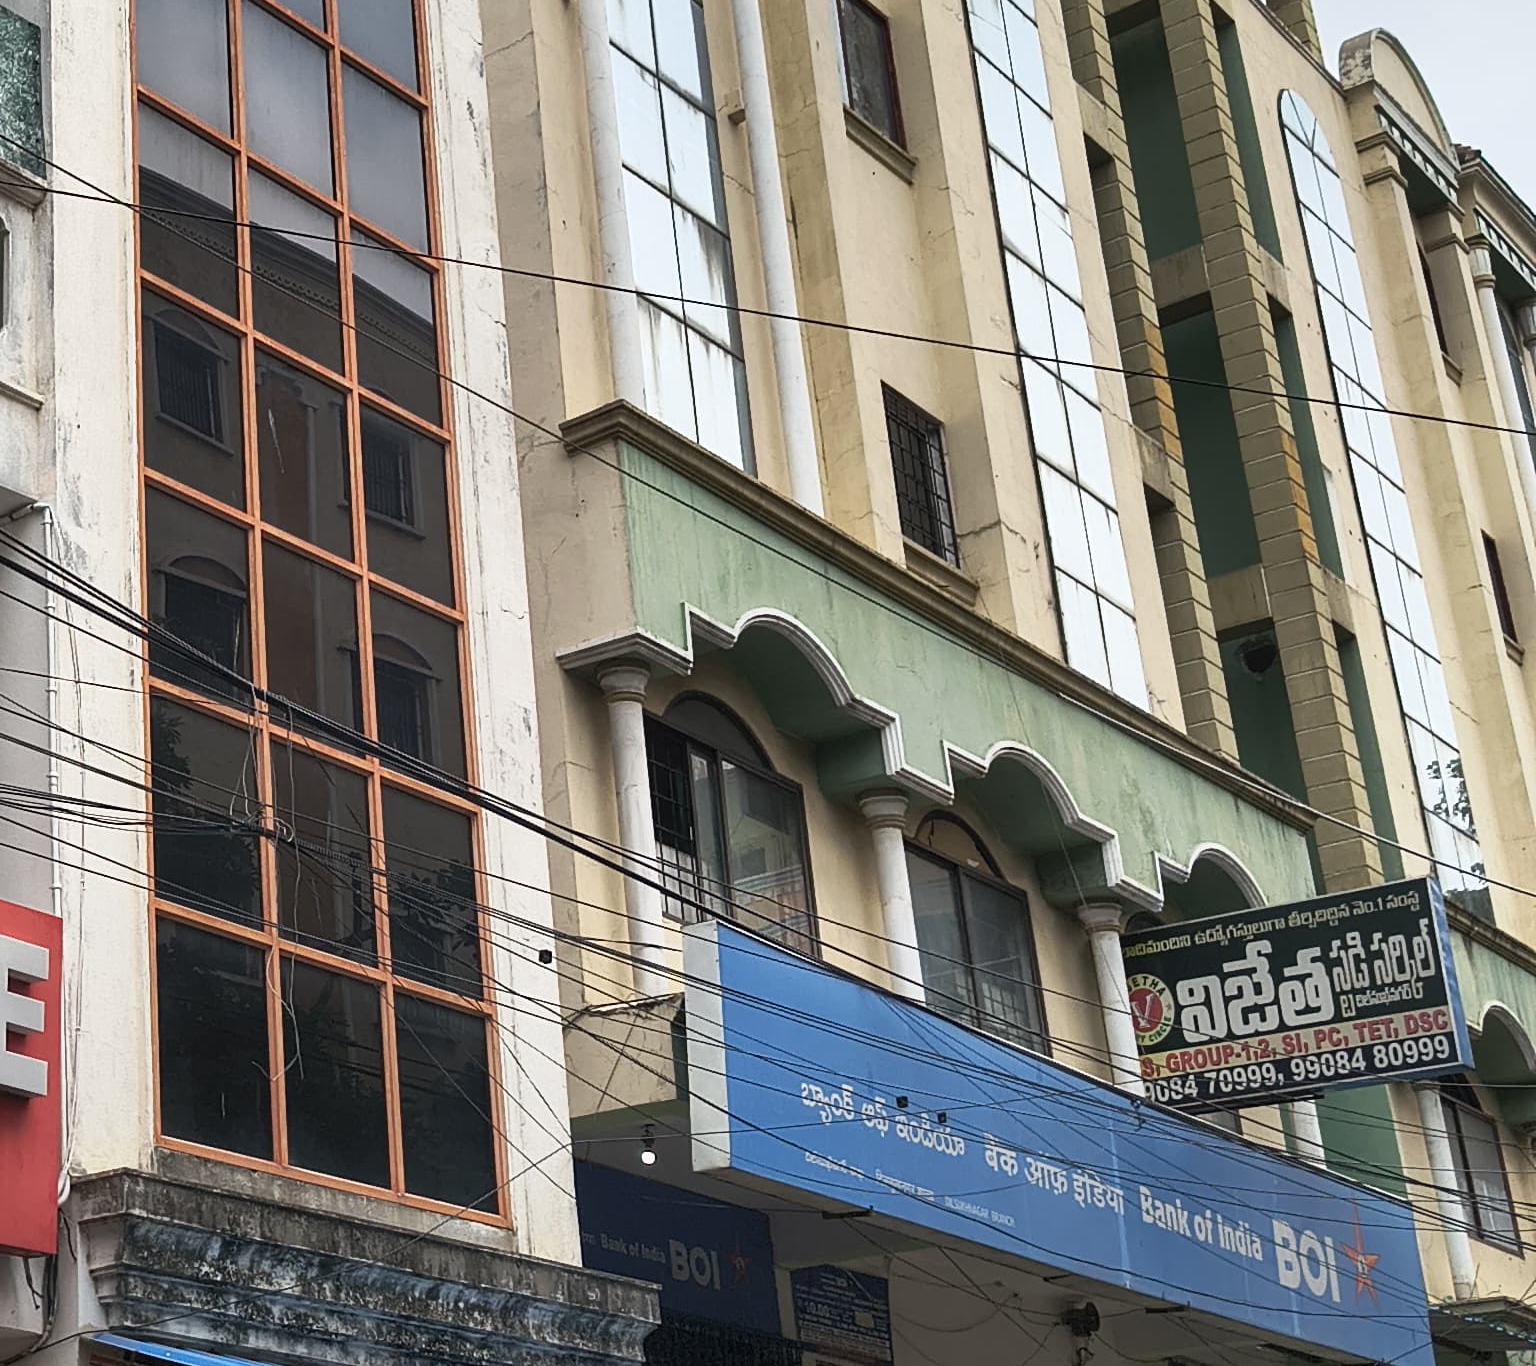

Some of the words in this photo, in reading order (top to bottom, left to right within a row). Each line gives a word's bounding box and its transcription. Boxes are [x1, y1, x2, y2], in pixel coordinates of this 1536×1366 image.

[1176, 940, 1335, 1043] విజేత
[1281, 1034, 1308, 1056] SI,
[1314, 1027, 1348, 1051] PC,
[1353, 1019, 1399, 1043] TET,
[1404, 1009, 1448, 1033] DSC
[1205, 1063, 1284, 1095] 70999,
[1291, 1048, 1365, 1081] 99084
[1373, 1036, 1449, 1066] 80999
[600, 1233, 628, 1255] Bank
[1140, 1185, 1191, 1237] Bank
[1194, 1210, 1214, 1244] of
[669, 1238, 721, 1291] BOI
[1272, 1218, 1340, 1303] BOI
